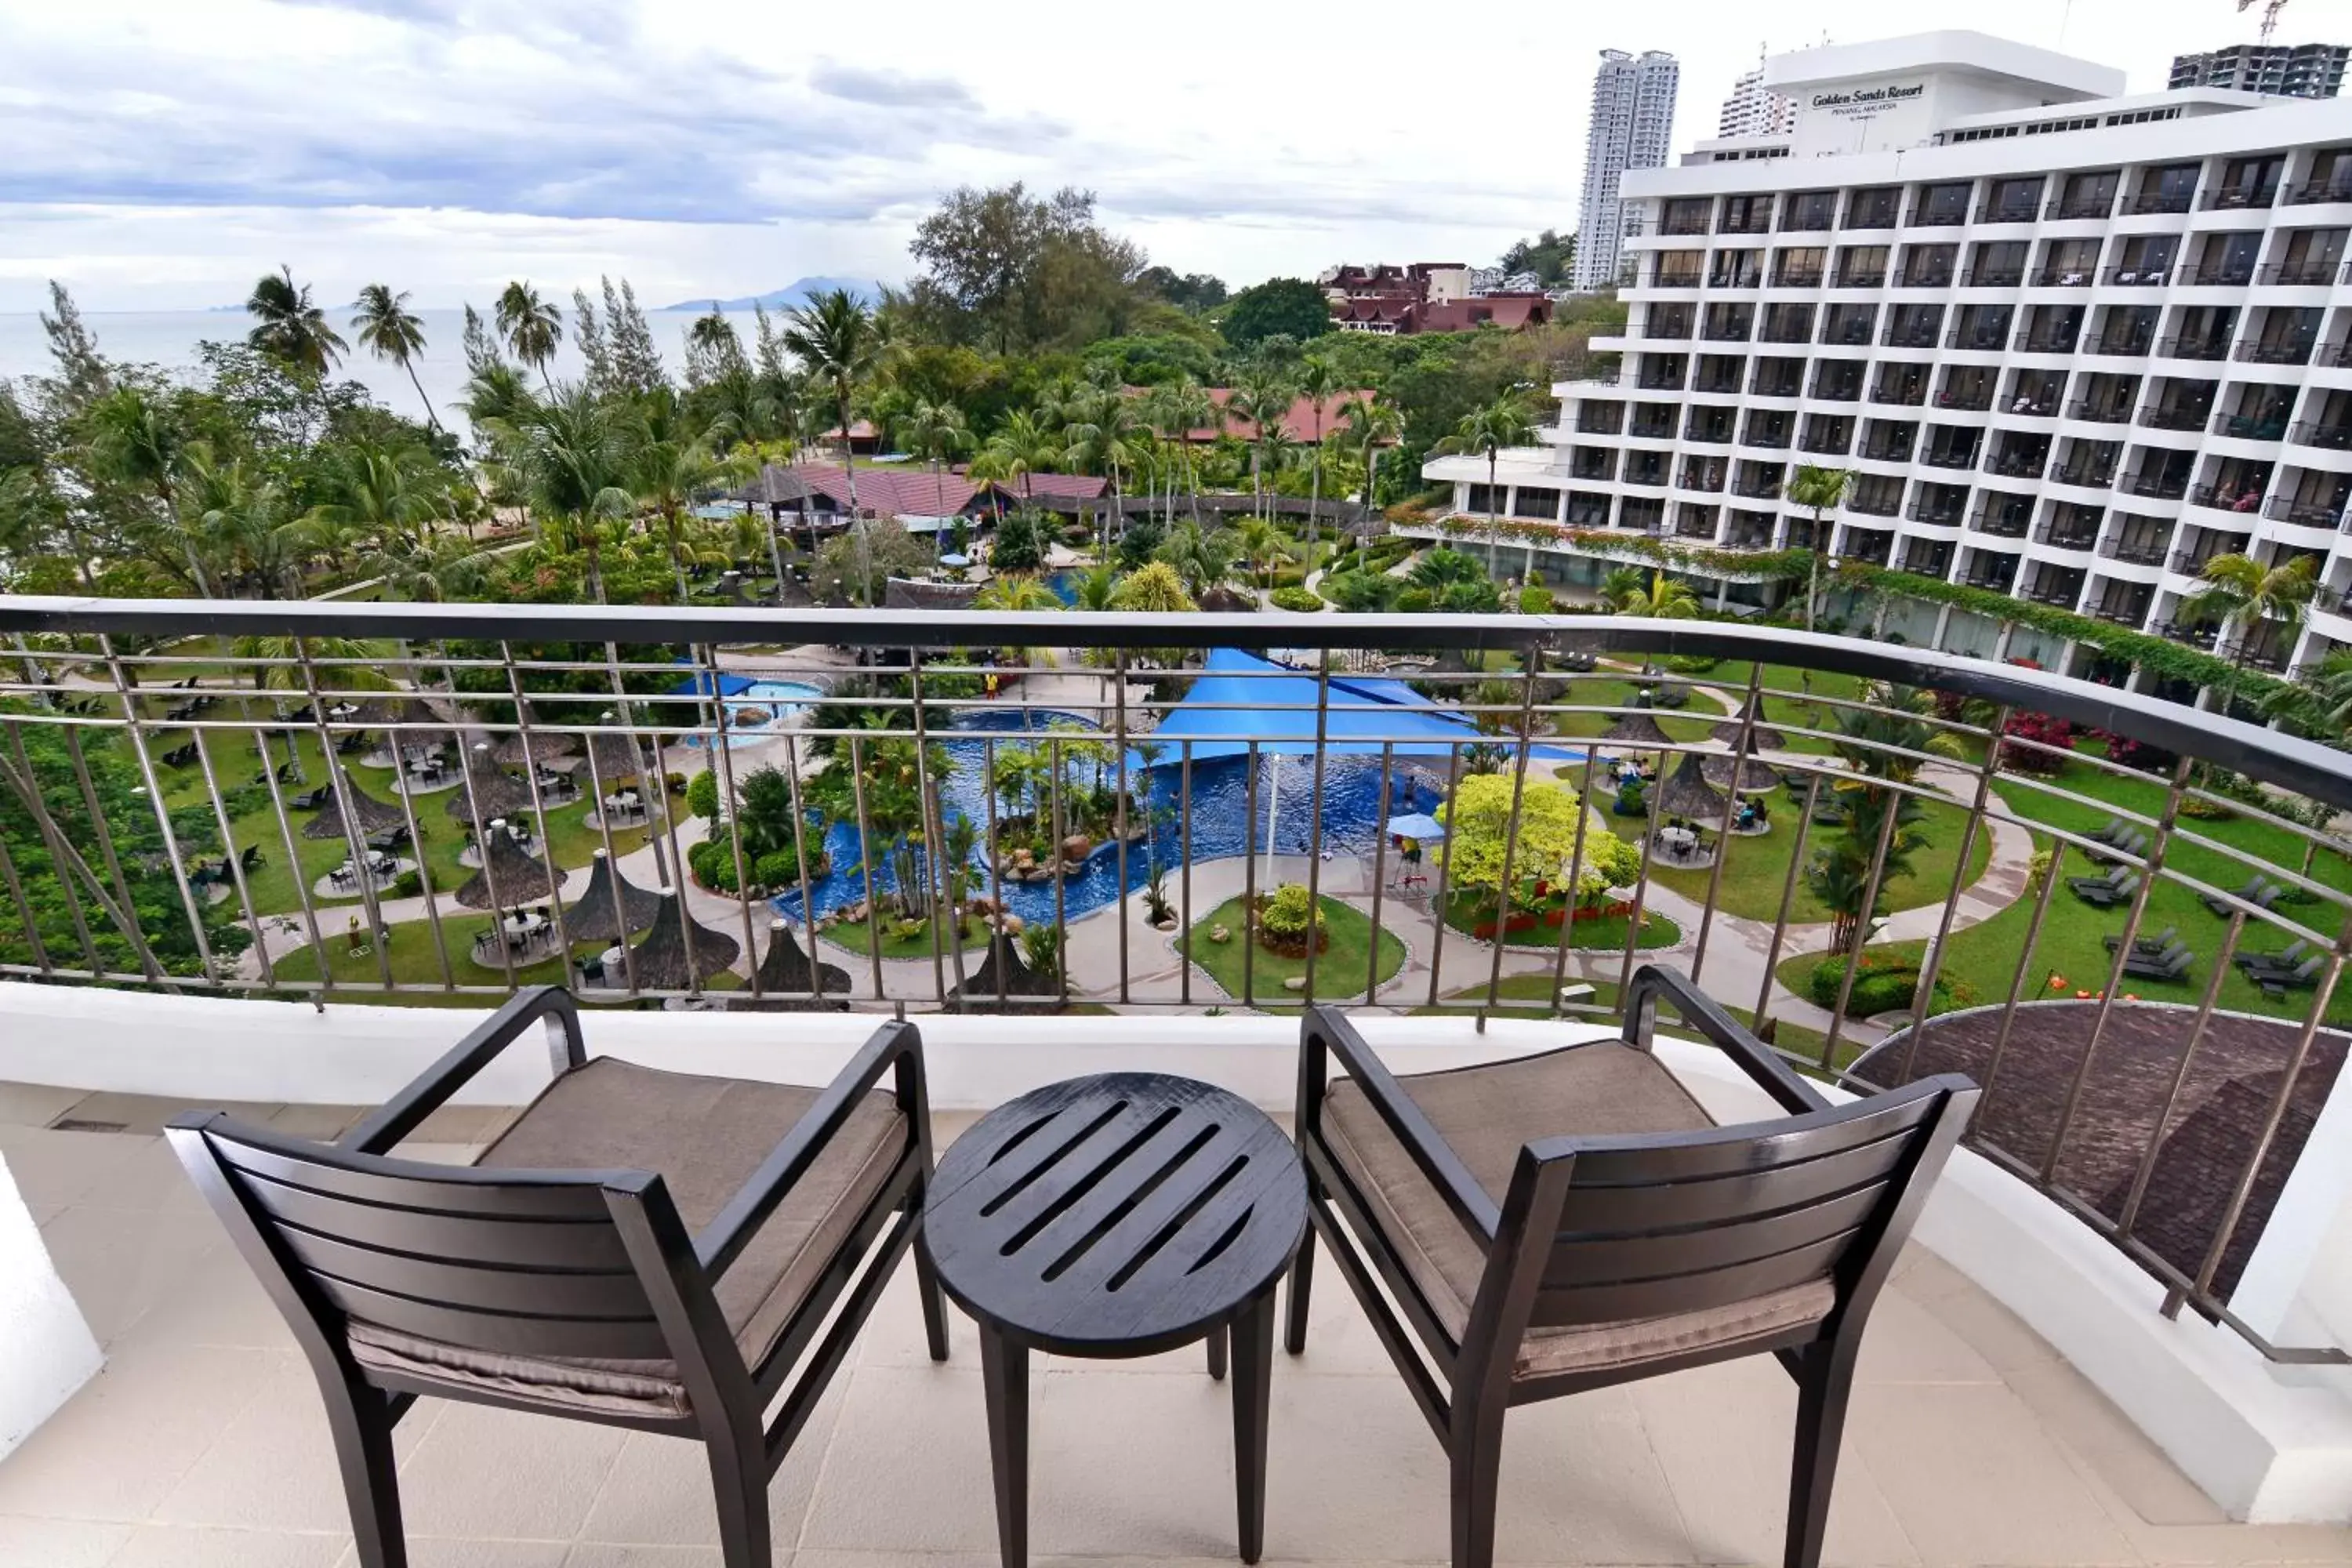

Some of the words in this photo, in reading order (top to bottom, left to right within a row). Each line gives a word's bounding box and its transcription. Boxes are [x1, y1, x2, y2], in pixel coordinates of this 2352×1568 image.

[1813, 95, 1850, 107] Golden
[1853, 89, 1886, 102] Sands
[1887, 84, 1923, 98] Resort
